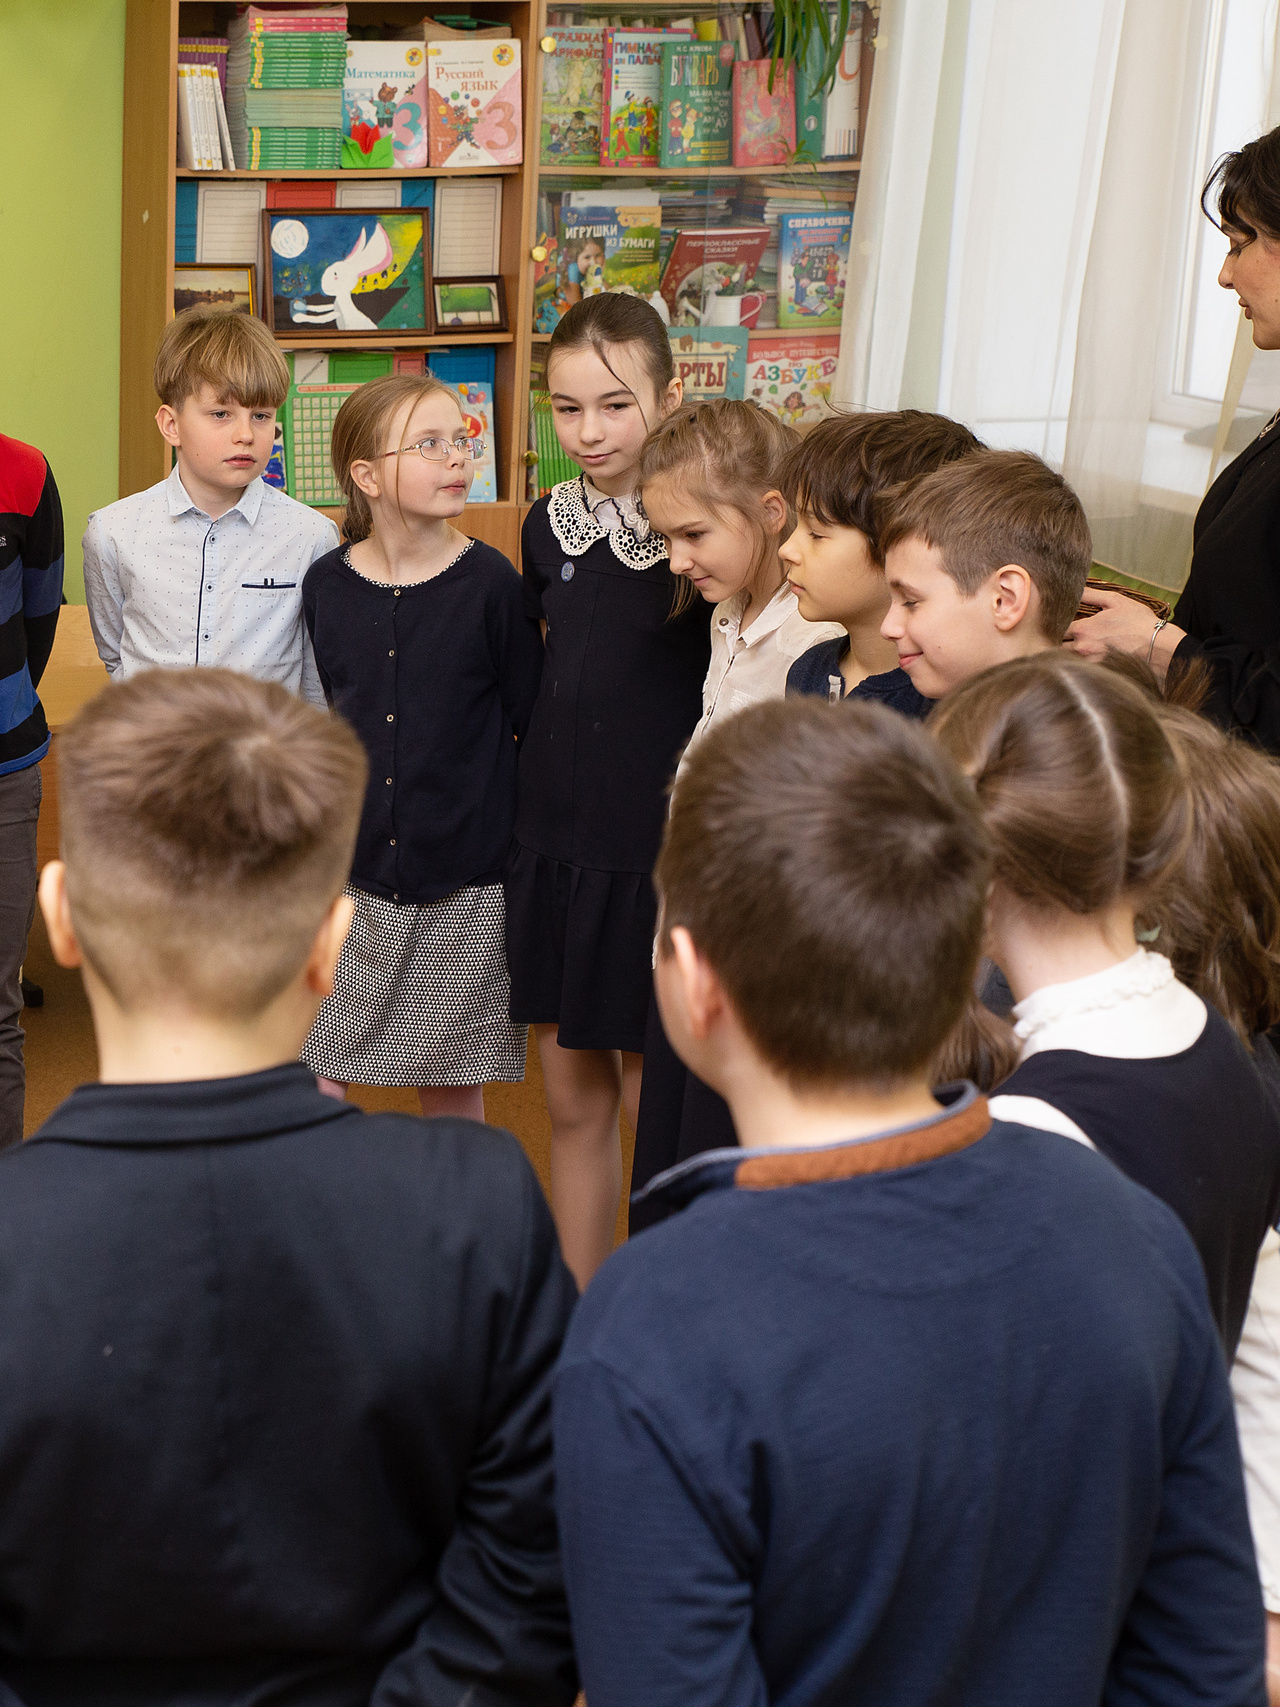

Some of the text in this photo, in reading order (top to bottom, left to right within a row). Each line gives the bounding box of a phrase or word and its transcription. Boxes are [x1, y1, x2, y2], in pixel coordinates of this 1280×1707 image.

[552, 32, 603, 43] ГРАММА
[346, 67, 416, 79] Математика
[435, 66, 485, 82] Русский
[670, 55, 719, 87] БУКВАРЬ
[393, 102, 423, 150] 3
[486, 101, 517, 150] 3
[788, 216, 851, 228] СПРАВОЧНИК
[565, 224, 618, 239] ИГРУШКИ
[606, 237, 655, 249] ИЗ БУМАГИ
[673, 362, 726, 387] РТЫ
[752, 358, 837, 385] АЗБУКЕ
